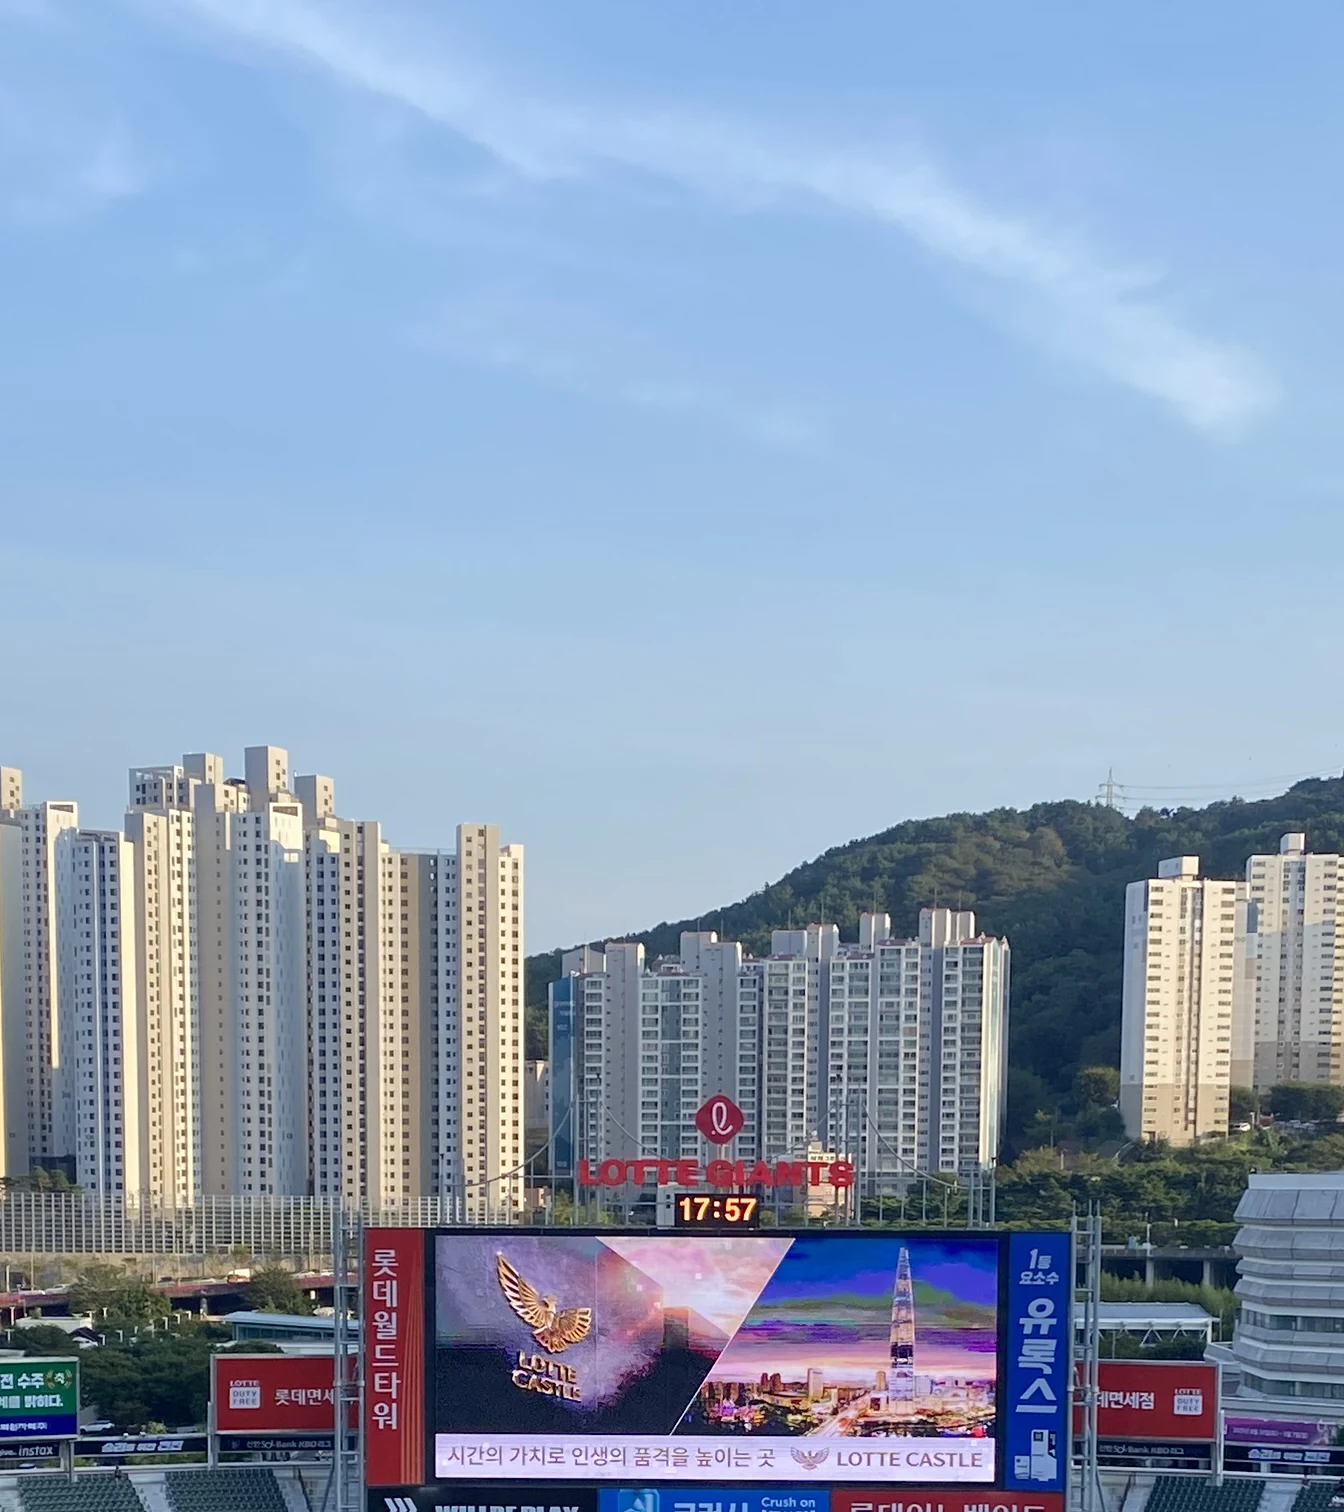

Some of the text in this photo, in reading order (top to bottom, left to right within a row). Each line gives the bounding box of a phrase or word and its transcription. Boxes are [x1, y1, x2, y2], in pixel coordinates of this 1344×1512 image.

[578, 1159, 854, 1188] LOTTE GIANTS
[679, 1197, 757, 1221] 17:57
[1019, 1272, 1059, 1285] 요소수
[372, 1249, 401, 1430] 롯데월드타워
[1015, 1298, 1058, 1414] 유록스
[516, 1351, 577, 1385] LOTTE
[17, 1372, 44, 1389] 수주
[512, 1369, 583, 1402] CASTLE
[18, 1445, 53, 1457] instax
[448, 1446, 776, 1468] 시간의 가치로 인생의 품격을 높이는 곳
[837, 1451, 983, 1468] LOTTE CASTLE
[761, 1497, 815, 1508] Crush on
